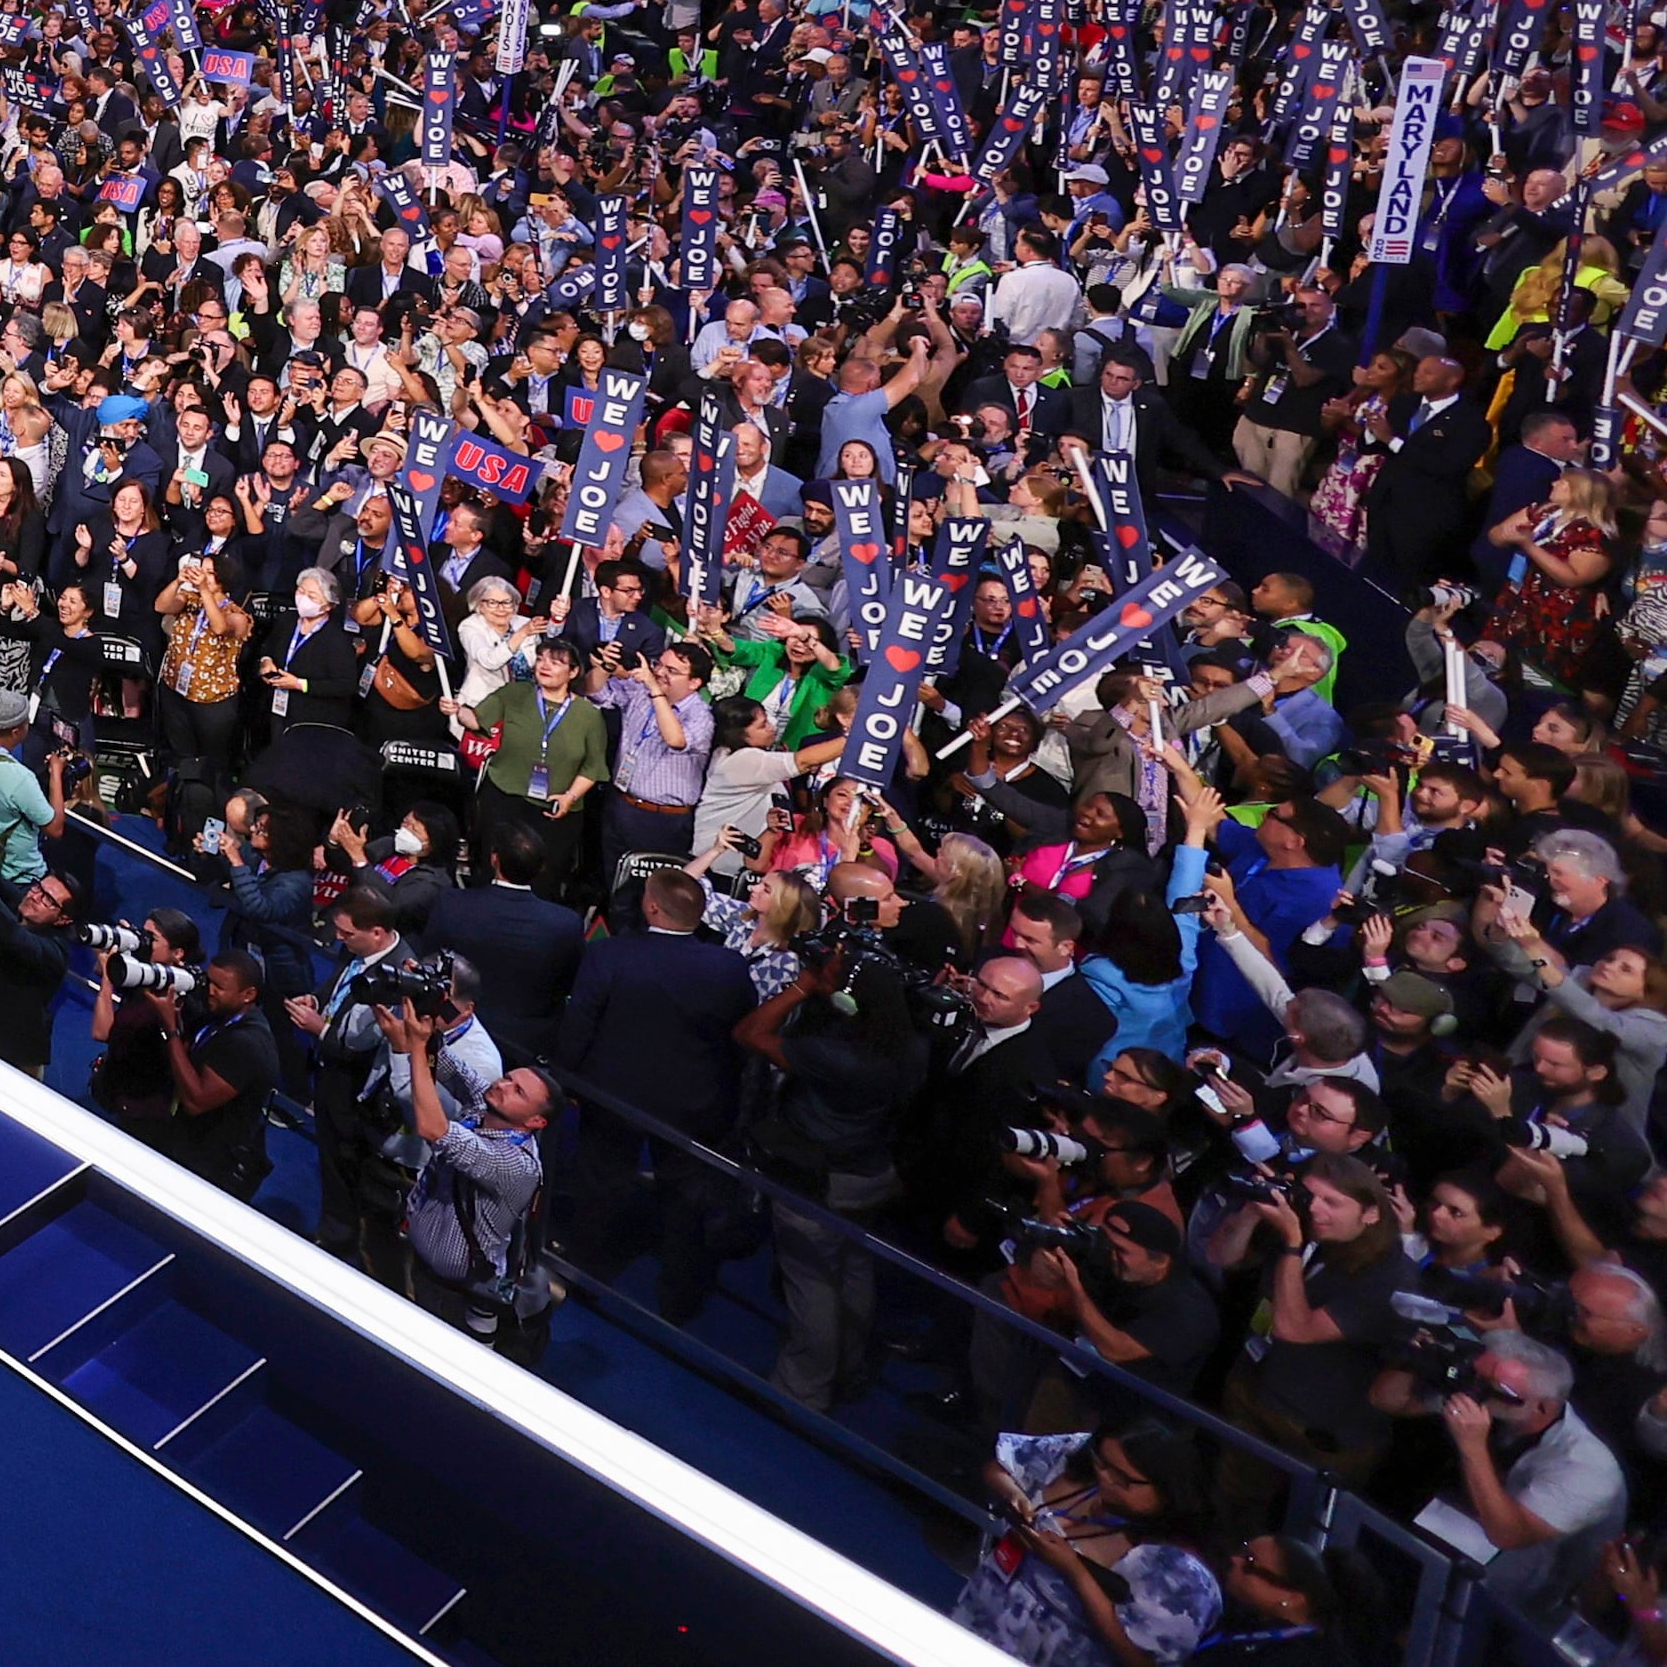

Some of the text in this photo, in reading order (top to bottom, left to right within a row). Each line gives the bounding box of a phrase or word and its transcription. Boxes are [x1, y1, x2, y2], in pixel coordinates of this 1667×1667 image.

[204, 53, 248, 78] USA
[1383, 84, 1435, 235] MARYLAND
[688, 170, 716, 281] WE JOE
[453, 439, 531, 494] USA
[1031, 553, 1217, 697] WE JOE
[857, 578, 944, 772] WE JOE
[389, 745, 436, 759] UNITED
[389, 754, 436, 768] CENTER
